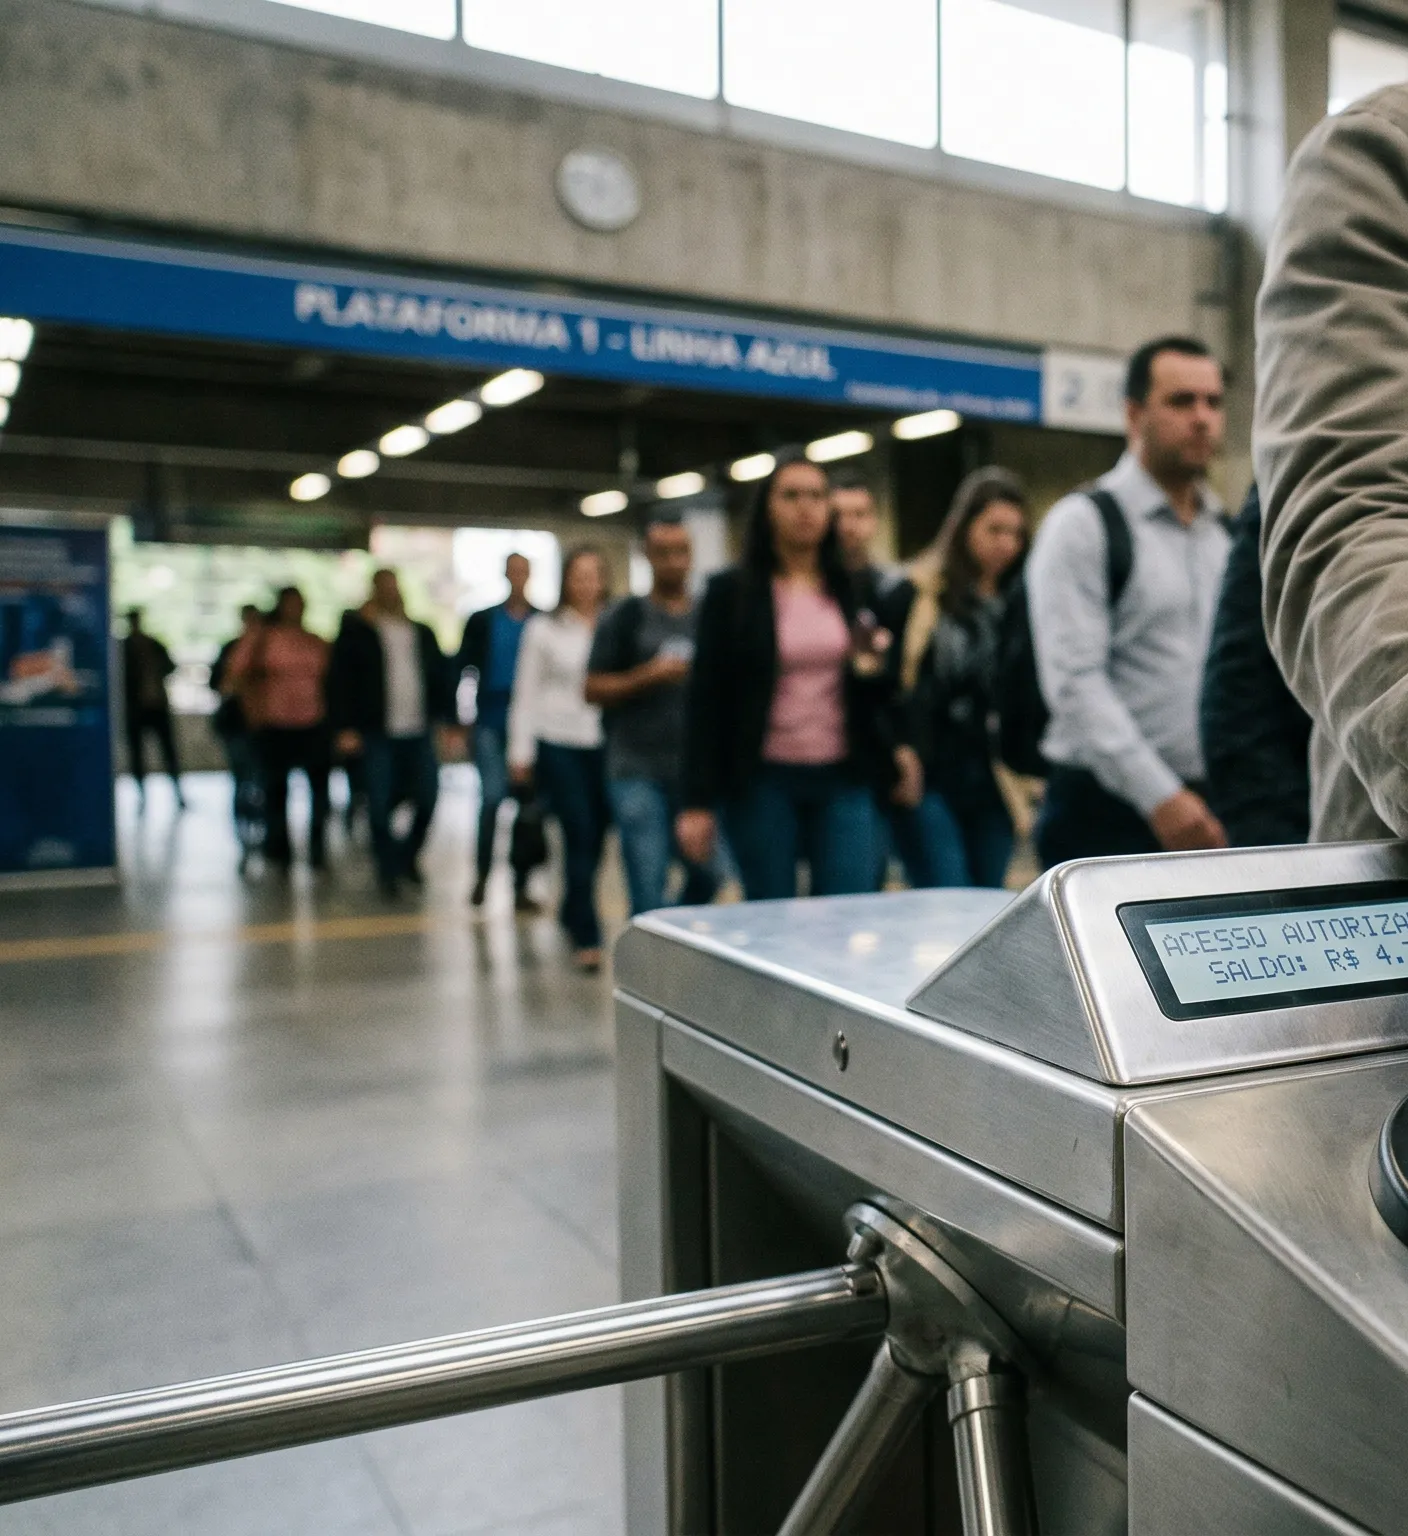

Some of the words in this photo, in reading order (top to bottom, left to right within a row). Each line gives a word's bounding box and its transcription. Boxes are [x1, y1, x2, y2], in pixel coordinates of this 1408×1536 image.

[294, 282, 571, 353] PLATAFORMA
[577, 315, 599, 356] 1
[630, 322, 743, 371] LINHA
[745, 337, 838, 382] AZUL
[1162, 925, 1267, 957] ACESSO
[1208, 953, 1308, 984] SALDO:
[1324, 946, 1360, 972] R$
